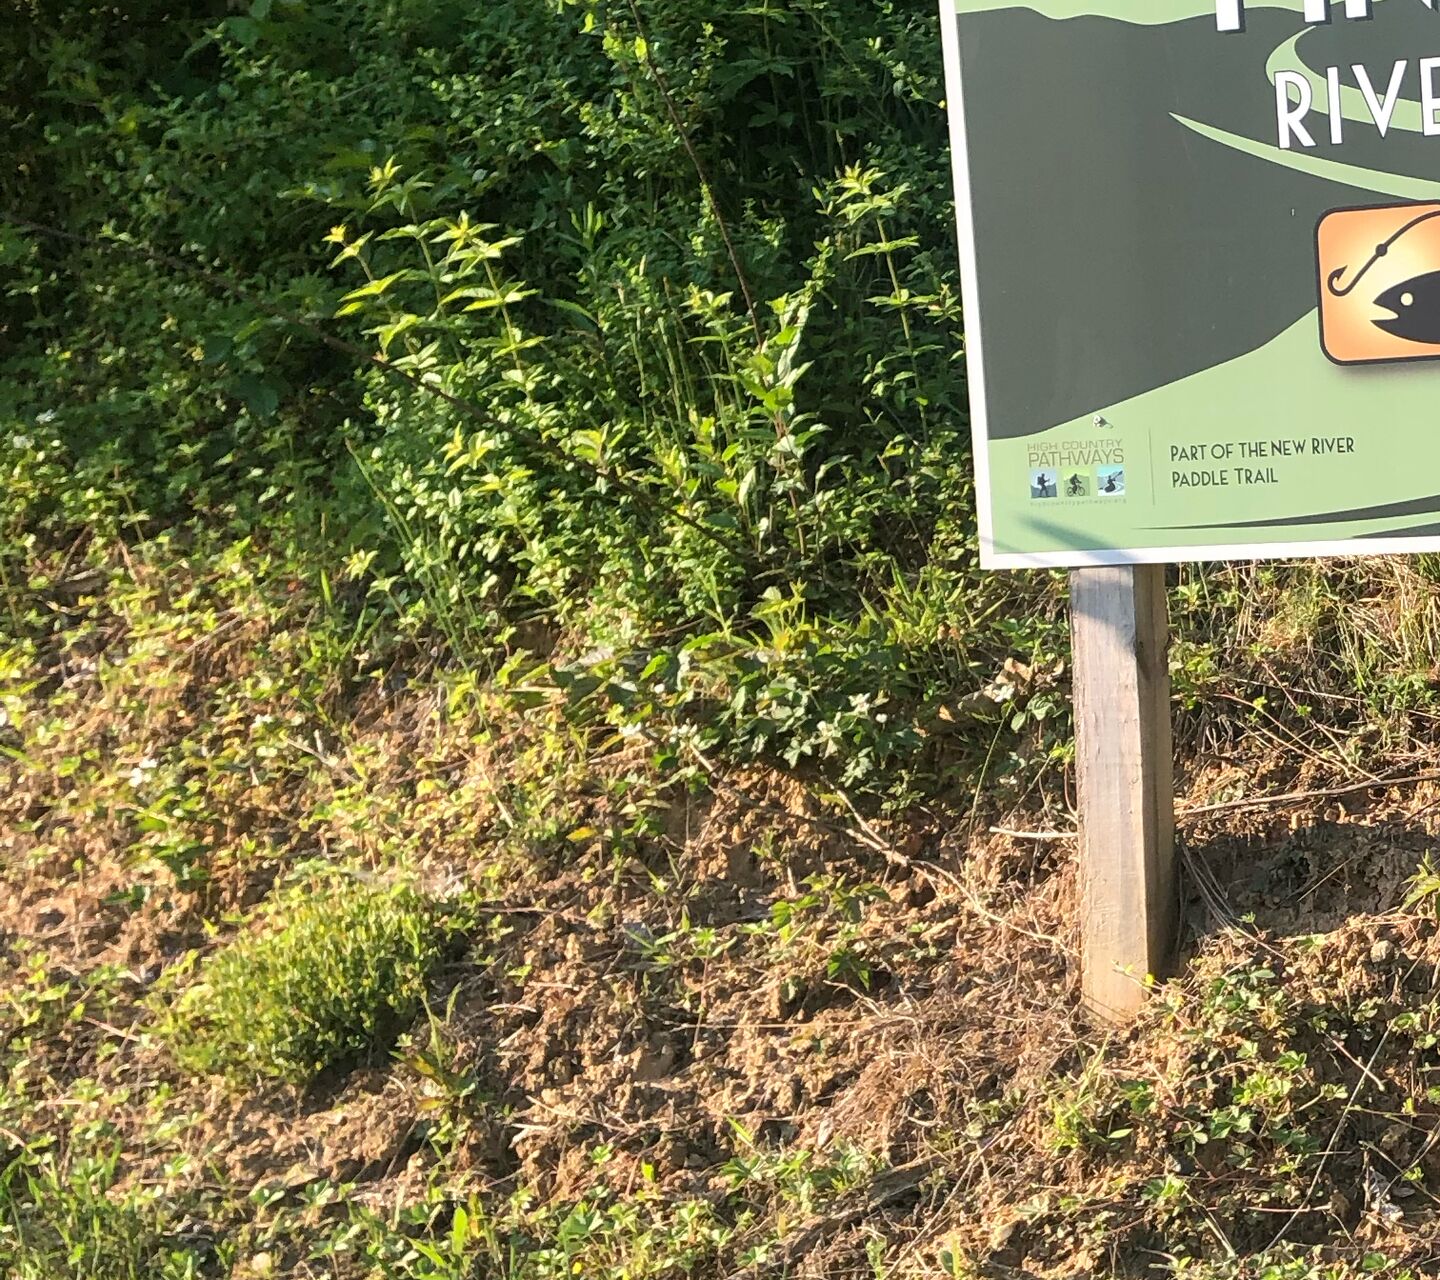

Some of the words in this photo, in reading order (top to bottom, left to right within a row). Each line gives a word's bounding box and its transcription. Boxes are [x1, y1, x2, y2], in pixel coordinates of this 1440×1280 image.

[1027, 442, 1058, 452] HIGH
[1061, 439, 1123, 451] COUNTRY
[1170, 444, 1207, 462] PART
[1210, 443, 1234, 460] OF
[1238, 441, 1268, 458] THE
[1271, 439, 1307, 456] NEW
[1311, 437, 1355, 455] RIVER
[1028, 448, 1125, 467] PATHWAYS
[1172, 469, 1229, 488] PADDLE
[1234, 467, 1279, 485] TRAIL
